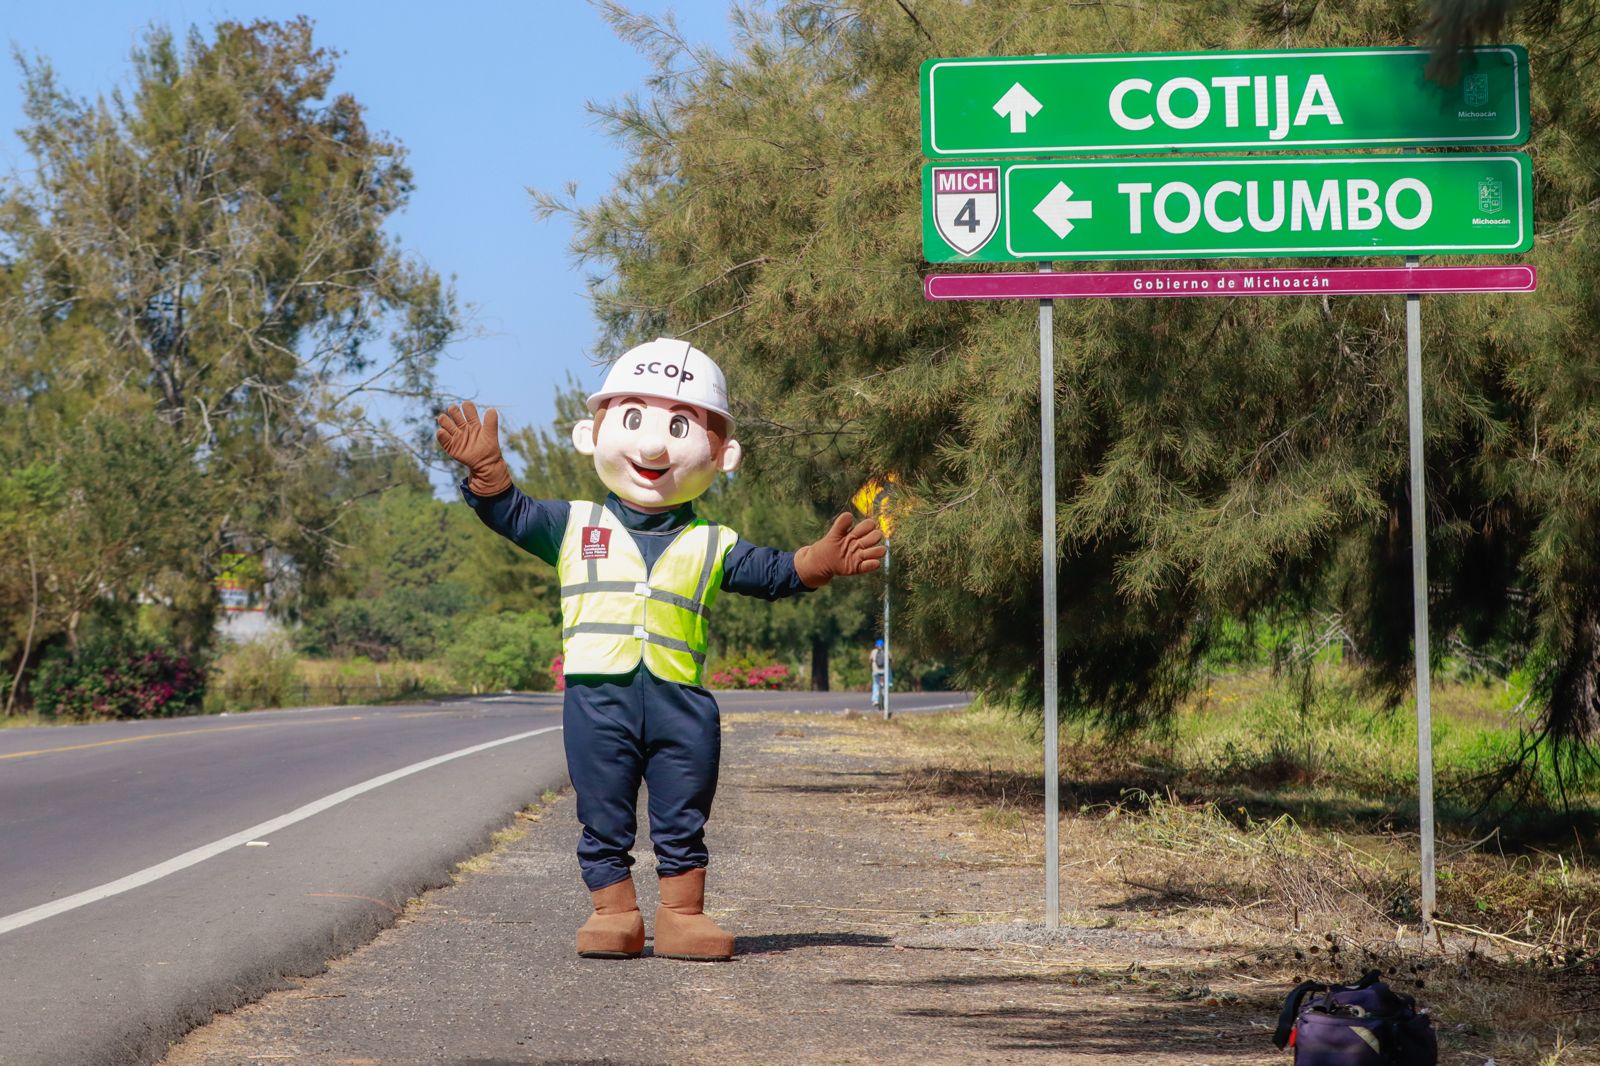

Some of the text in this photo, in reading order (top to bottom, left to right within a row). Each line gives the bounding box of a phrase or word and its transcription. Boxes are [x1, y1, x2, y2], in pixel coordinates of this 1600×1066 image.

[1108, 74, 1344, 140] COTIJA
[939, 172, 993, 191] MICH
[953, 198, 980, 233] 4
[1117, 177, 1433, 234] TOCUMBO
[1471, 217, 1511, 225] Michoacán
[1133, 275, 1329, 290] Gobierno de Michoacán
[633, 361, 694, 383] SCOP
